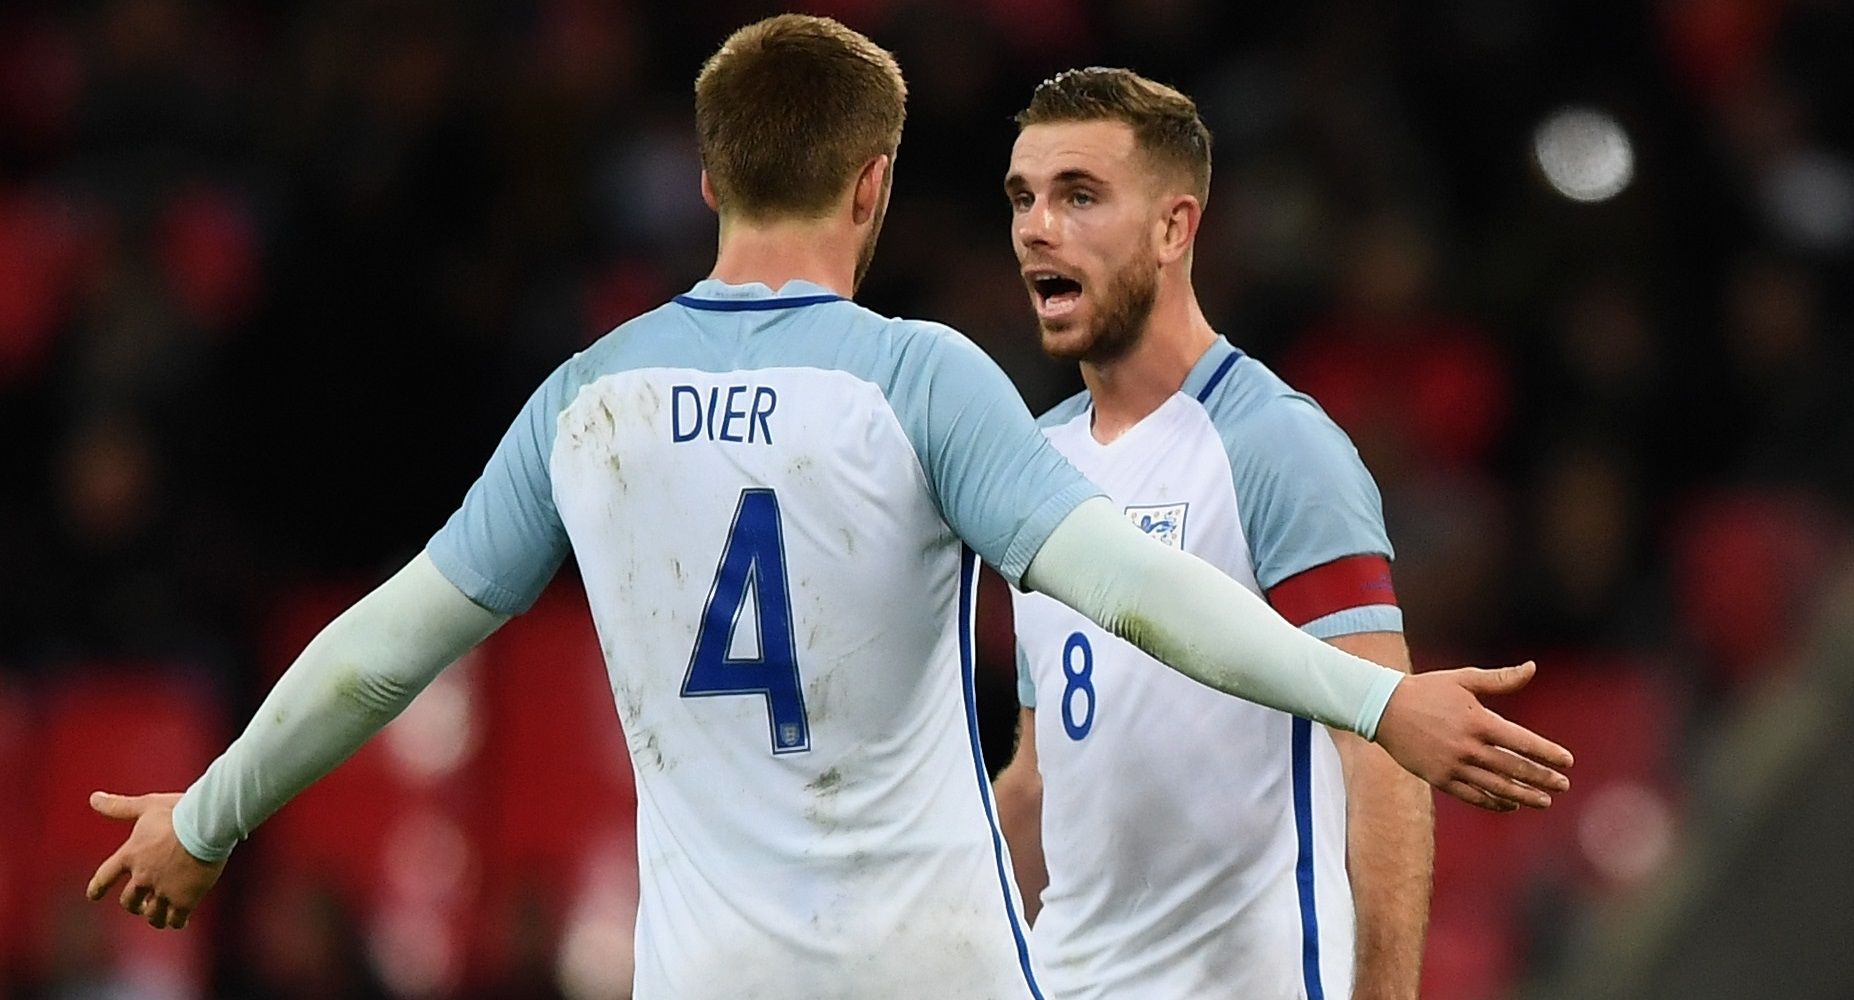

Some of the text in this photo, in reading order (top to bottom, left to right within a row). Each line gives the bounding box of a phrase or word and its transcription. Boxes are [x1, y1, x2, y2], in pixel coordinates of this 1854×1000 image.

[672, 385, 777, 445] DIER
[680, 488, 811, 755] 4
[1062, 631, 1096, 741] 8
